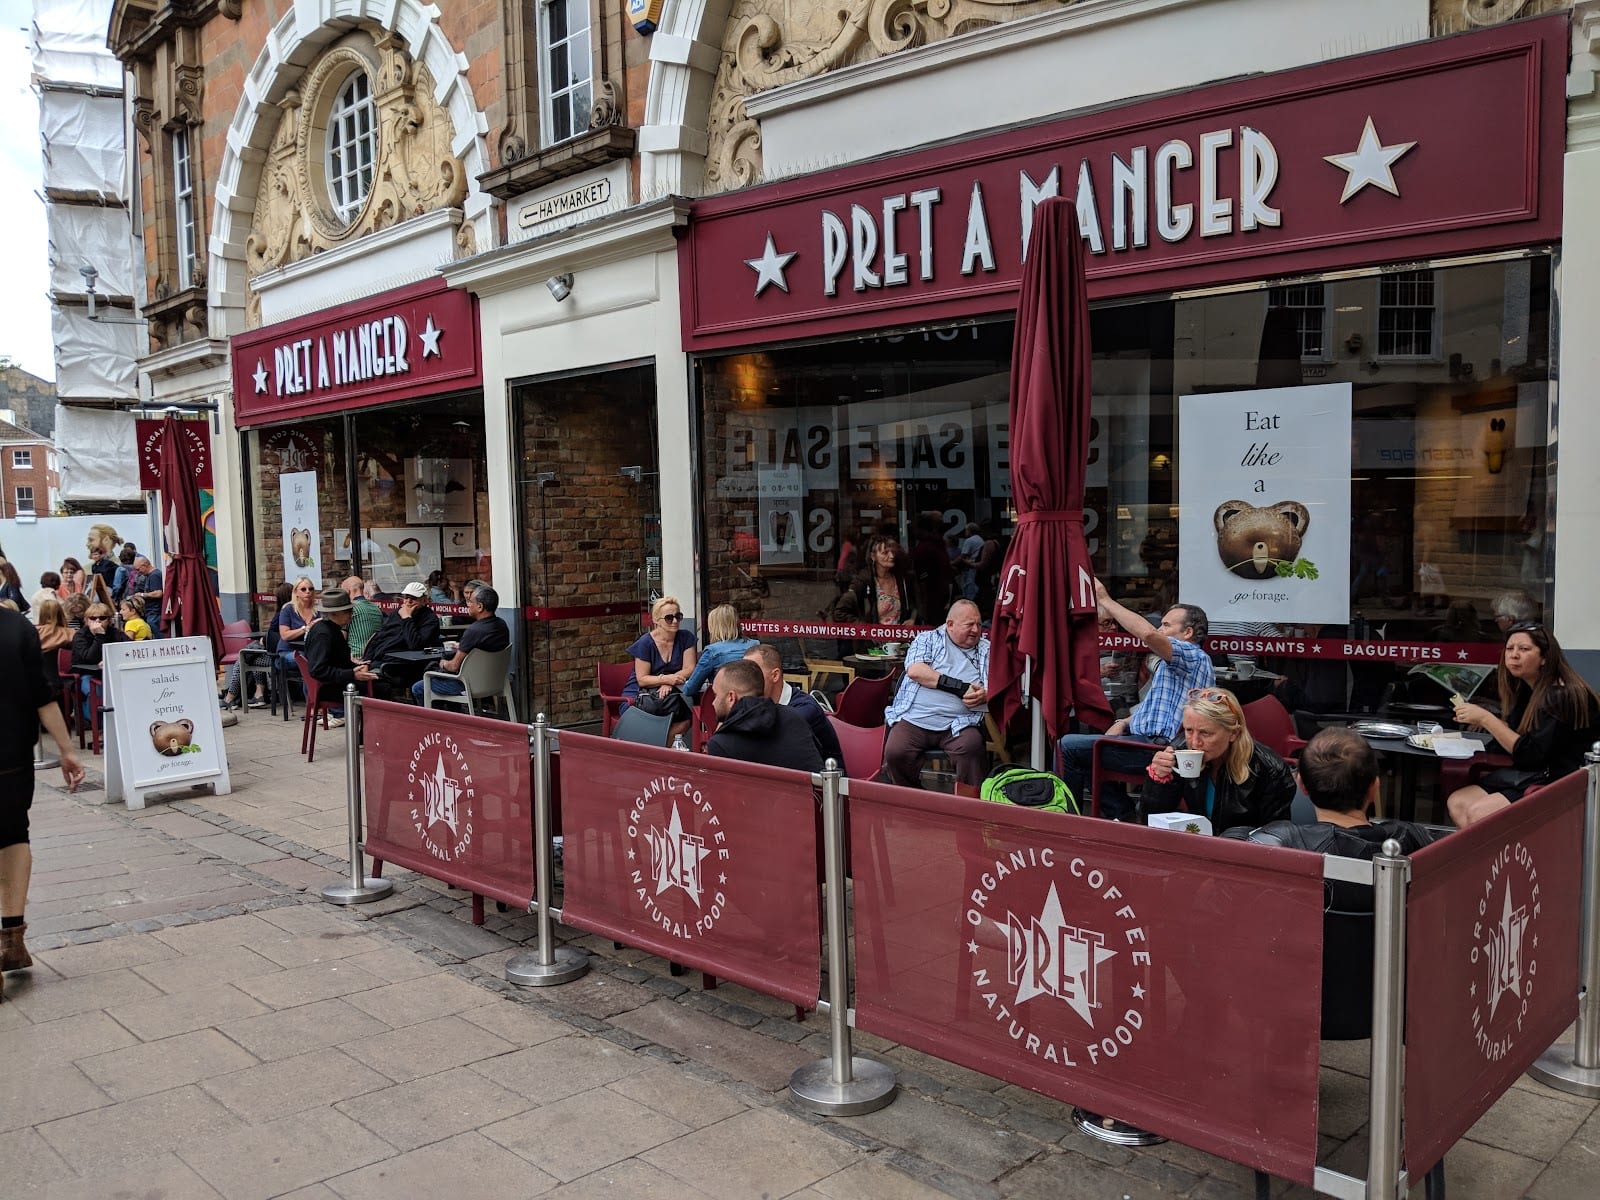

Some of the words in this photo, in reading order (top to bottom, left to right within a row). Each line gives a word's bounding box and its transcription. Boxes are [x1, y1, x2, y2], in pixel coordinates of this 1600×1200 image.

[540, 184, 604, 218] HAYMARKET
[822, 187, 941, 296] PRET
[960, 180, 995, 274] A
[1020, 125, 1281, 264] MANGER
[275, 338, 312, 397] PRET
[318, 336, 331, 389] A
[332, 315, 410, 385] MANGER
[1244, 411, 1280, 431] Eat
[1240, 442, 1284, 467] like
[1254, 479, 1265, 493] a
[1229, 590, 1249, 604] go
[1252, 589, 1289, 603] forage.
[132, 648, 149, 659] PRET
[160, 644, 190, 657] MANGER
[793, 625, 856, 636] SANDWICHES
[1210, 640, 1305, 653] CROISSANTS
[1344, 644, 1441, 659] BAGUETTES
[152, 673, 180, 684] salads
[153, 688, 176, 703] for
[154, 704, 184, 716] spring
[408, 732, 440, 783] ORGANIC
[446, 736, 474, 798] COFFEE
[424, 771, 459, 824] PRET
[628, 776, 676, 838] ORGANIC
[683, 782, 730, 860] COFFEE
[411, 808, 451, 861] NATURAL
[454, 824, 473, 858] FOOD
[651, 824, 704, 894] PRET
[632, 870, 692, 939] NATURAL
[696, 892, 726, 936] FOOD
[966, 848, 1054, 926] ORGANIC
[1070, 858, 1151, 966] COFFEE
[1470, 844, 1510, 964] ORGANIC
[1515, 842, 1541, 920] COFFEE
[1007, 910, 1104, 1008] PRET
[1488, 904, 1527, 1004] PRET
[973, 969, 1077, 1066] NATURAL
[1086, 1009, 1143, 1064] FOOD
[1472, 1006, 1513, 1060] NATURAL
[1517, 960, 1536, 1032] FOOD
